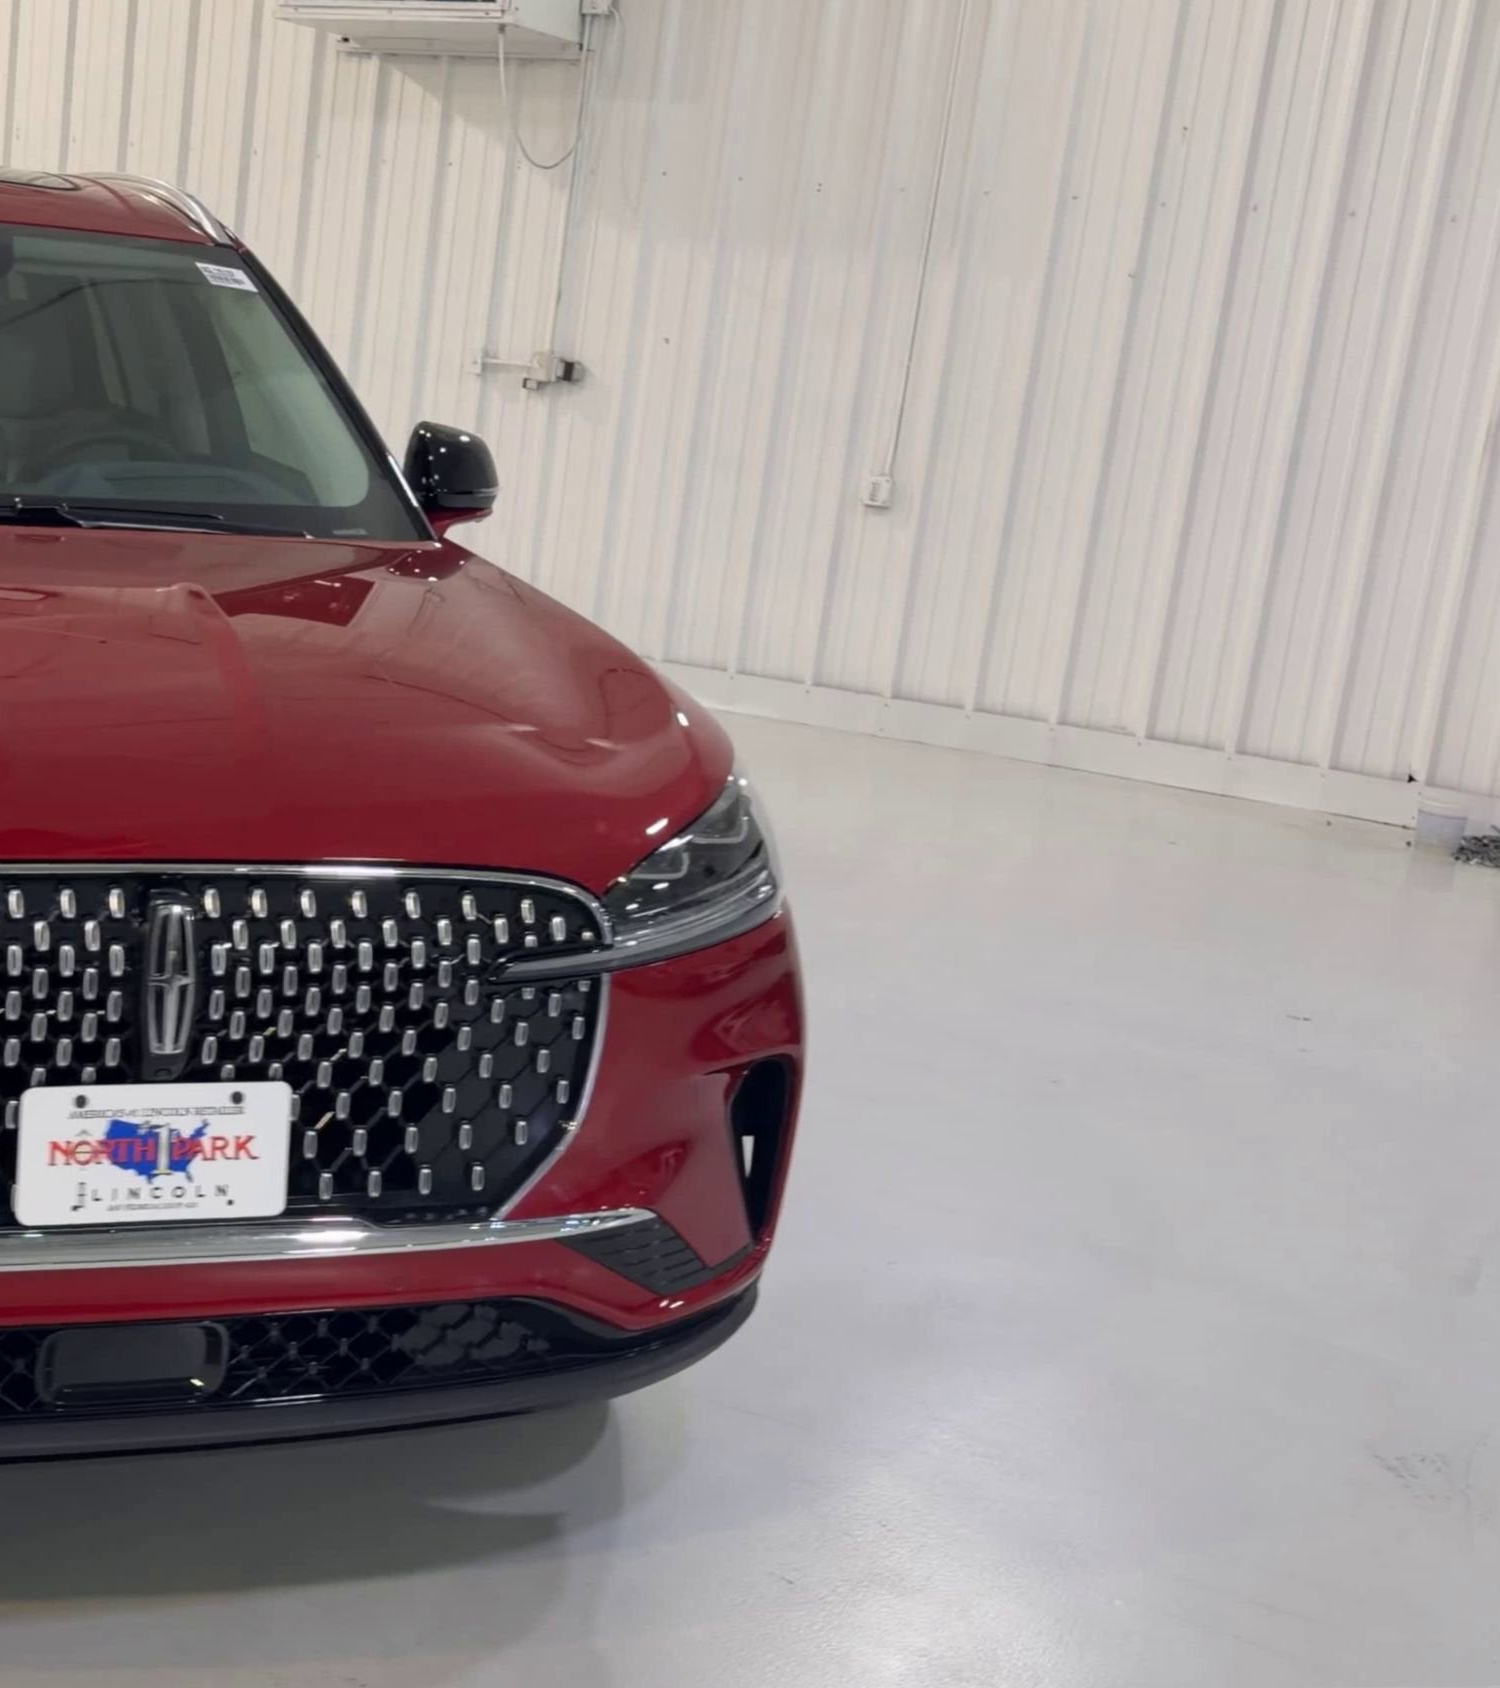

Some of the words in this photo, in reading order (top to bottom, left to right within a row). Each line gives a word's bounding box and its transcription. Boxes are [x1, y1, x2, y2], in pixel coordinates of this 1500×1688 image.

[47, 1137, 157, 1166] NORTH
[172, 1135, 260, 1162] PARK
[91, 1184, 229, 1202] LINCOLN
